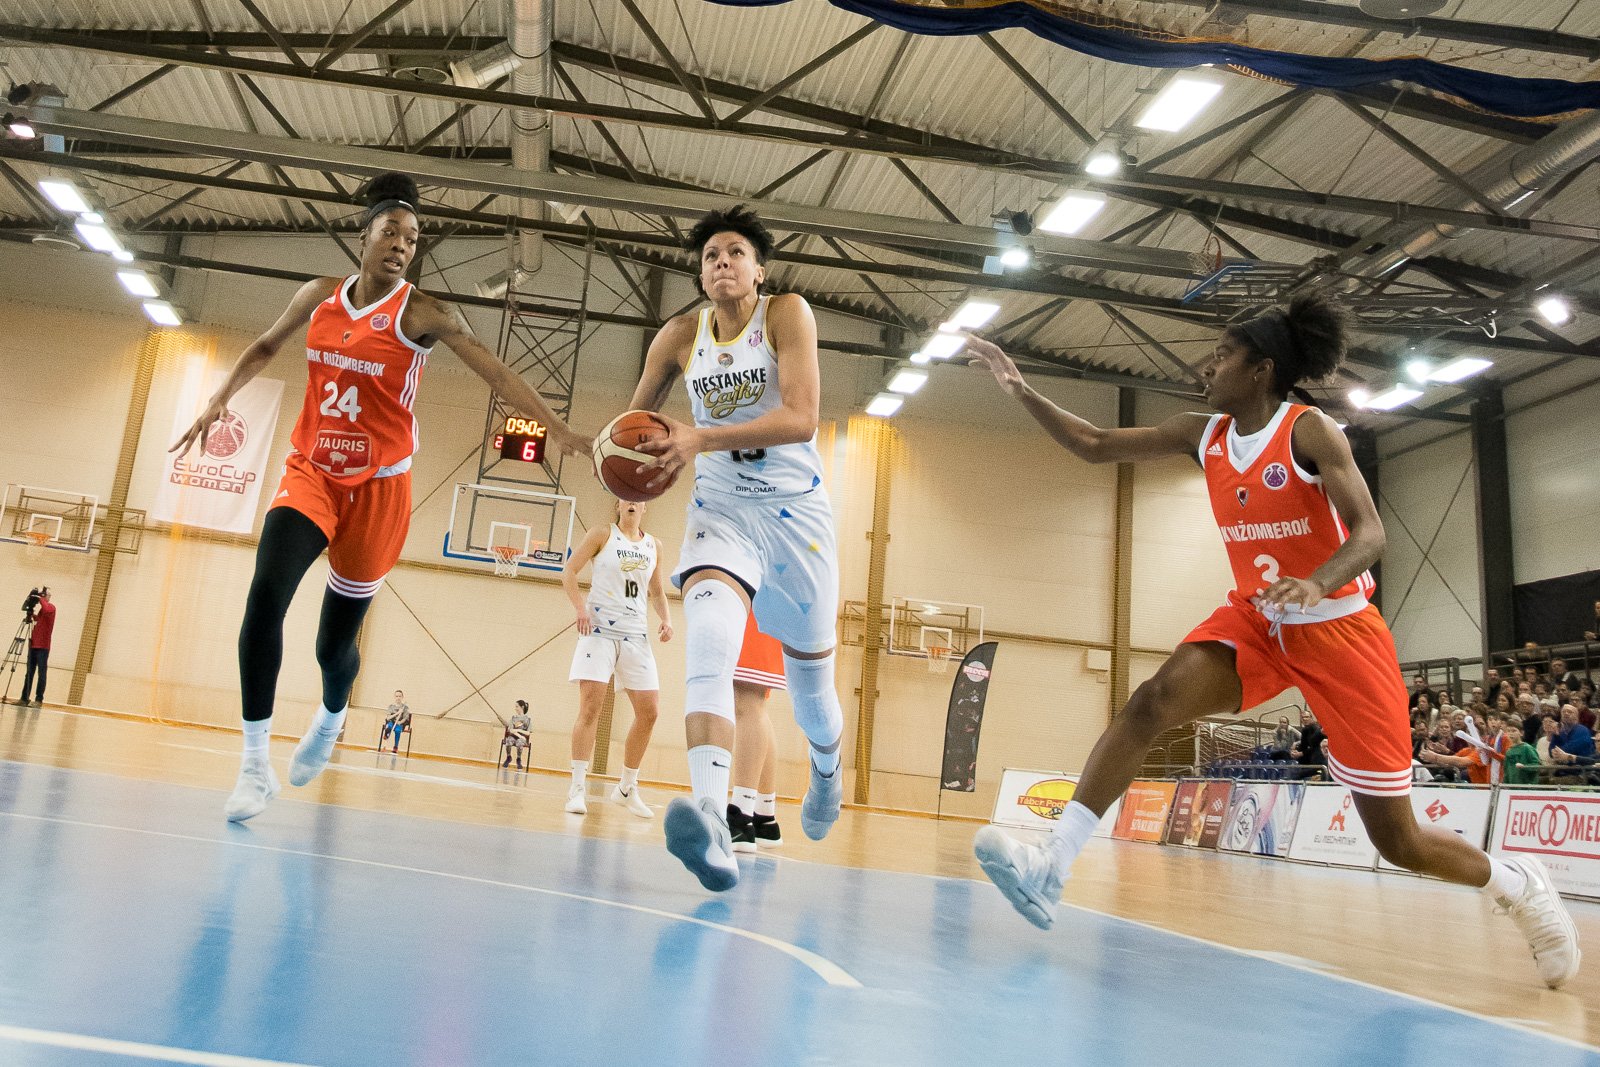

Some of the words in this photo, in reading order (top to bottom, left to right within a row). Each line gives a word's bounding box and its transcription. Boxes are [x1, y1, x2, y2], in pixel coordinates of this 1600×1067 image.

[323, 350, 386, 377] RUŽOMBEROK
[320, 381, 362, 423] 24
[318, 437, 366, 452] TAURIS
[522, 441, 536, 461] 6
[173, 458, 256, 483] EuroCup
[172, 473, 245, 493] women
[735, 485, 777, 494] DIPLOMAT
[625, 579, 639, 598] 10
